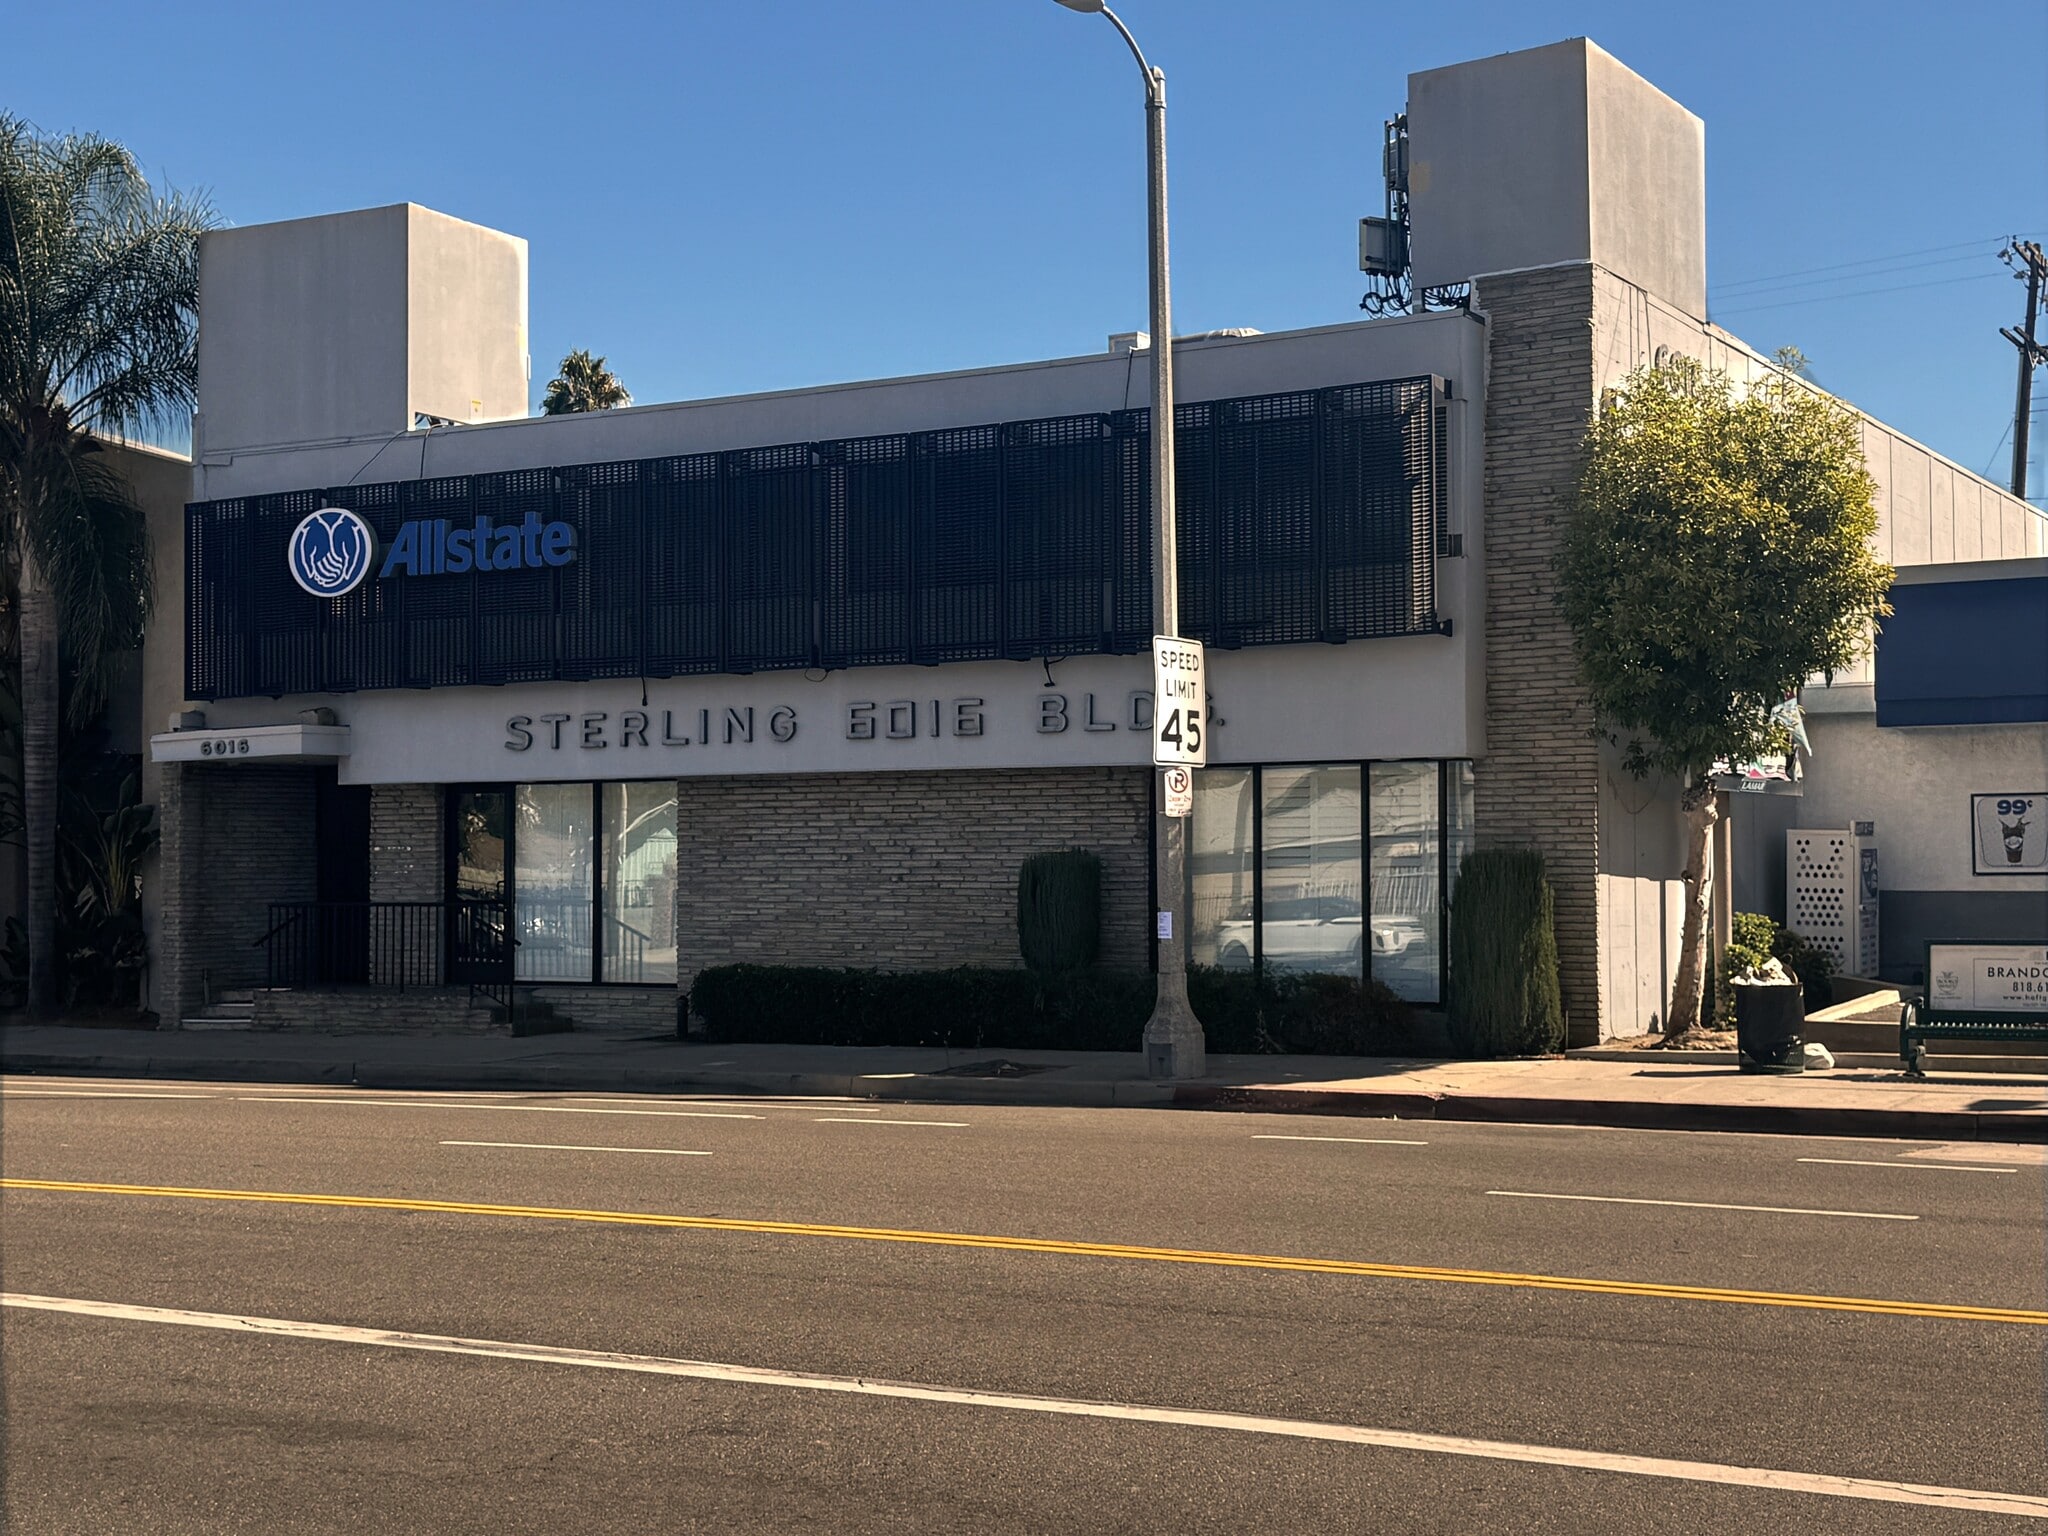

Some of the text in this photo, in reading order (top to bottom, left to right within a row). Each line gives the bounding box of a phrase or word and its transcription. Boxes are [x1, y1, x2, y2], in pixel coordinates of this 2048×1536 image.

[379, 511, 575, 578] Allstate
[1161, 650, 1199, 671] SPEED
[1166, 679, 1196, 699] LIMIT
[504, 691, 1226, 751] STERLING 6016 BLD.
[1161, 708, 1201, 753] 45
[201, 738, 249, 756] 6016
